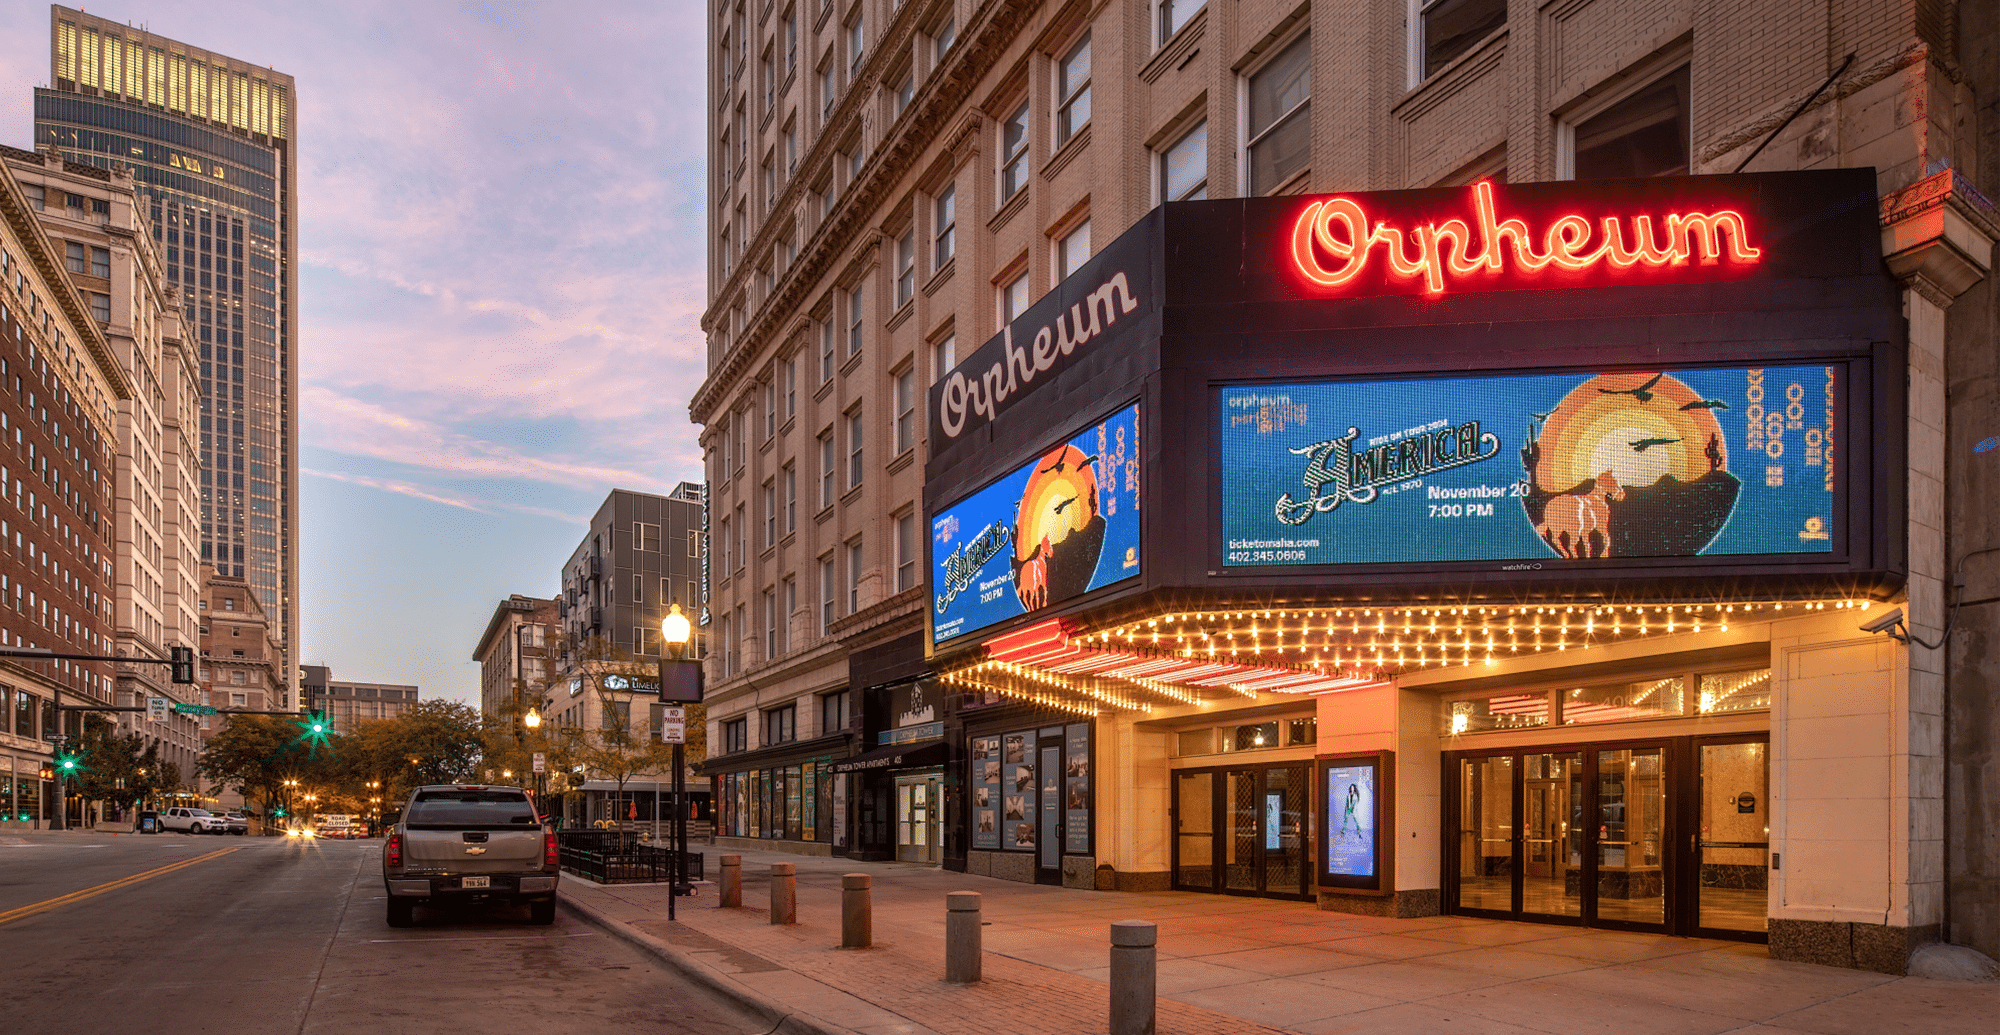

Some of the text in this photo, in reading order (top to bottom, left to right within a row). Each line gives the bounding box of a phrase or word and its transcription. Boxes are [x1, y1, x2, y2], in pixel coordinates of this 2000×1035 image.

[1292, 182, 1761, 292] Orpheum
[941, 271, 1138, 438] Orpheum
[1428, 483, 1531, 500] November 20
[1428, 503, 1494, 518] 7:00 PM
[1229, 537, 1320, 550] ticketomaha.com
[1229, 550, 1306, 562] 402.345.0606
[1502, 563, 1531, 571] watchfire
[980, 574, 1008, 593] November
[1008, 568, 1016, 581] 20
[993, 587, 1004, 599] PM
[670, 709, 679, 717] NO
[853, 761, 867, 770] TOWER
